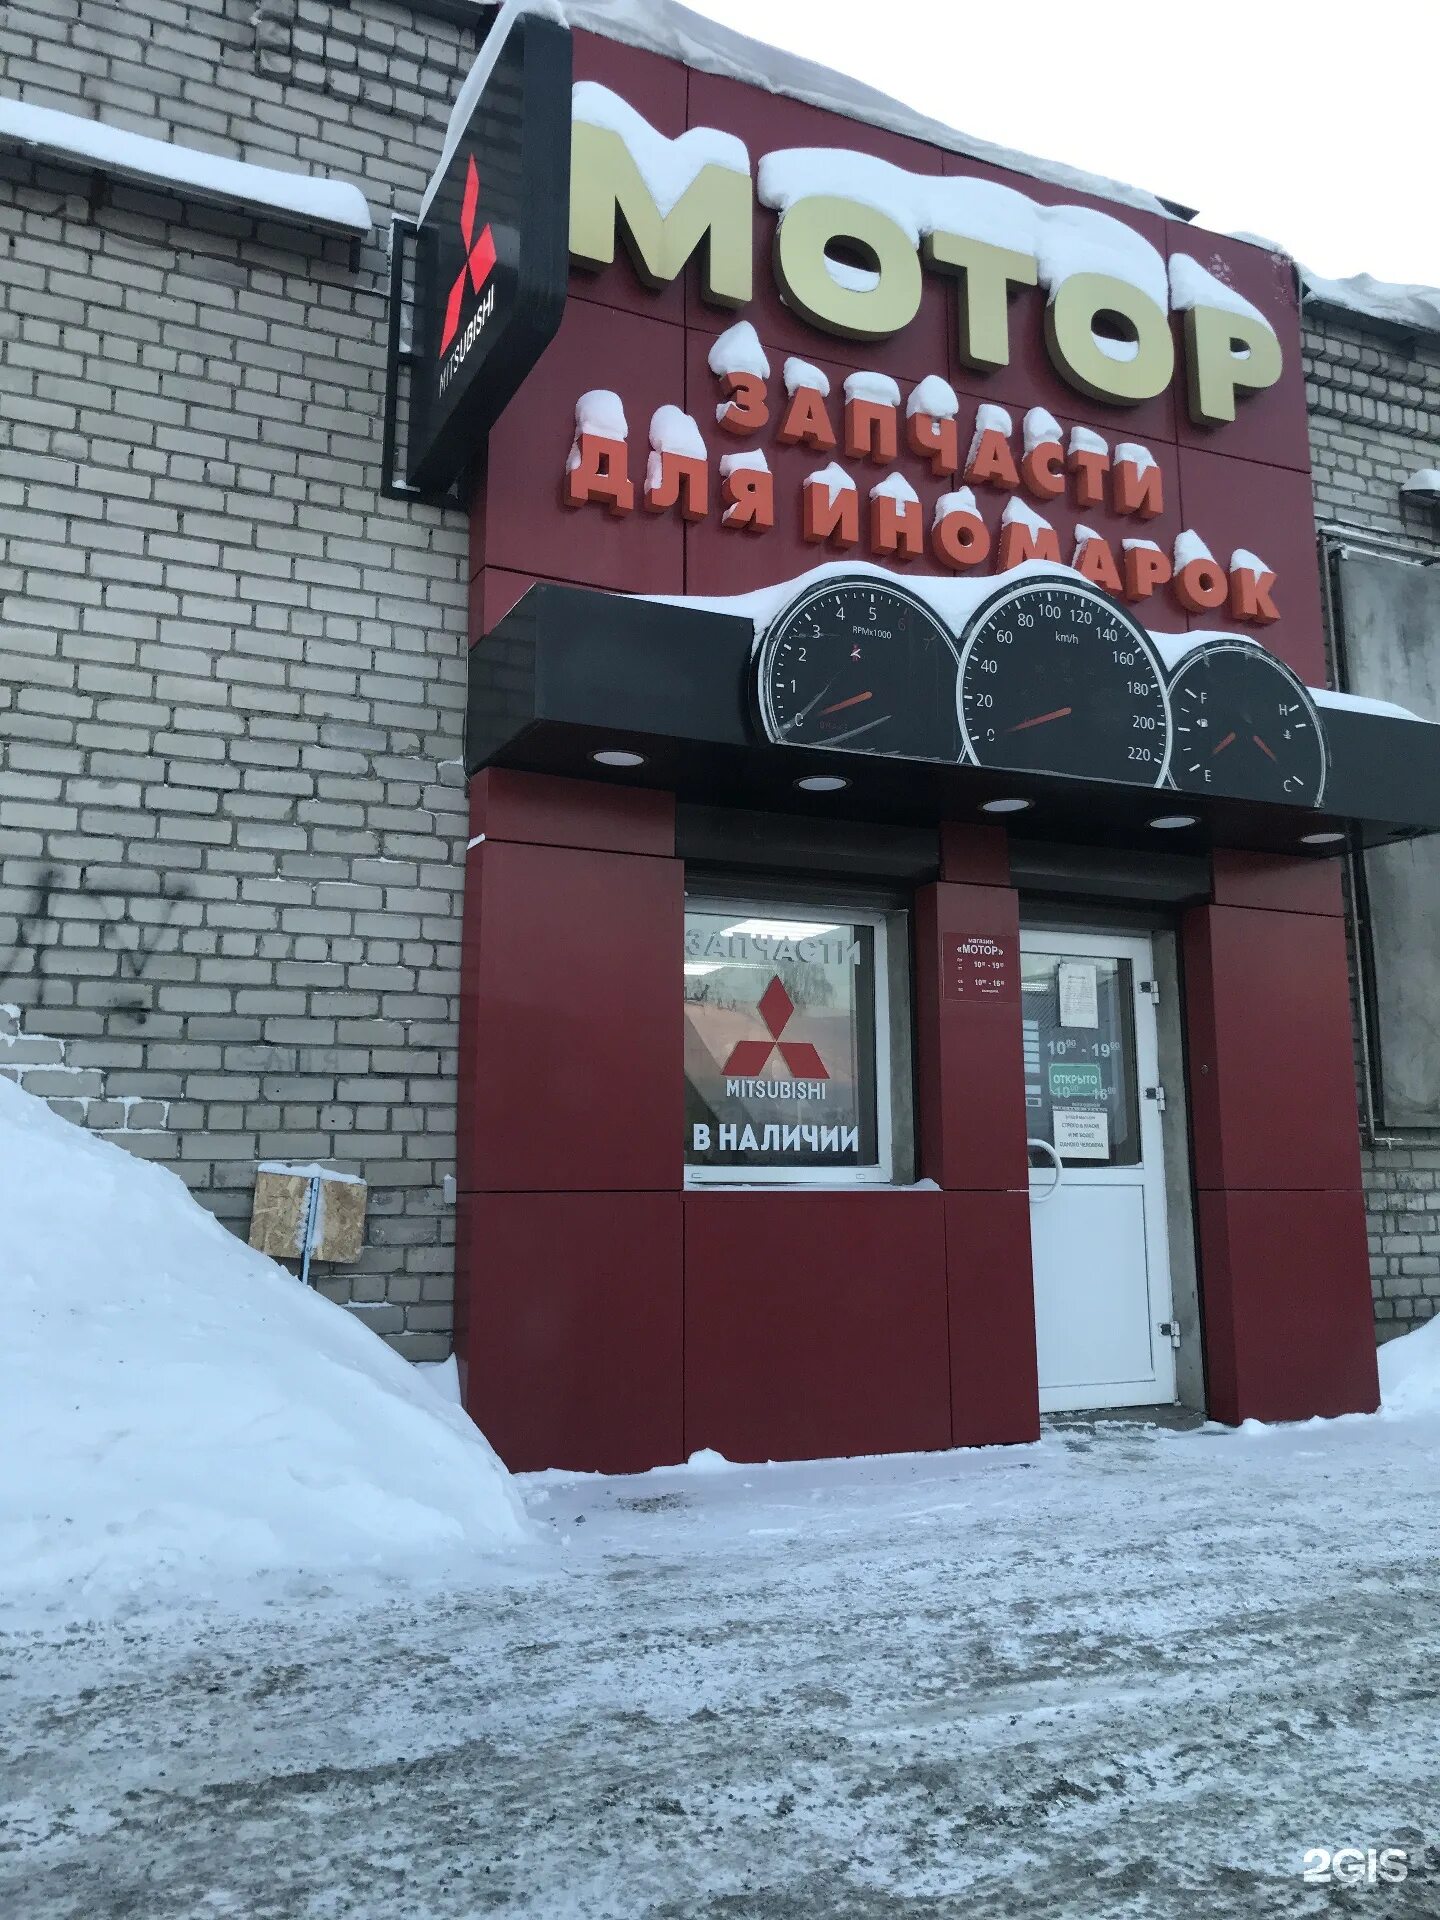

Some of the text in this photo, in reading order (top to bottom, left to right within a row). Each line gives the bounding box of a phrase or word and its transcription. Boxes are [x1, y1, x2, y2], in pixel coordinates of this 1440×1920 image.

[569, 118, 1284, 428] МОТОР
[439, 283, 495, 399] MITSUBISHI
[717, 370, 1164, 519] ЗАПЧАСТИ
[566, 432, 1281, 624] ДЛЯ ИНОМАРОК
[836, 607, 845, 621] 4
[869, 607, 877, 621] 5
[1038, 604, 1061, 619] 100
[1069, 609, 1092, 624] 120
[1017, 614, 1034, 628] 80
[812, 624, 821, 639] 3
[852, 625, 892, 639] RPMx1000
[996, 630, 1013, 644] 60
[1055, 631, 1079, 645] km/h
[1096, 627, 1118, 642] 140
[798, 648, 807, 662] 2
[1112, 651, 1135, 666] 160
[981, 660, 998, 674] 40
[790, 679, 796, 693] 1
[1126, 681, 1149, 696] 180
[976, 694, 993, 708] 20
[1200, 692, 1207, 704] F
[1278, 703, 1288, 717] H
[1132, 715, 1155, 730] 200
[986, 728, 995, 742] 0
[1127, 746, 1151, 761] 220
[1204, 769, 1212, 782] E
[1283, 779, 1292, 793] C
[686, 928, 861, 965] ЗАПЧАСТИ
[956, 944, 1004, 956] «МОТОР»
[1053, 1074, 1098, 1085] ОТКРЫТО
[726, 1079, 827, 1100] MITSUBISHI
[692, 1123, 860, 1152] В НАЛИЧИИ
